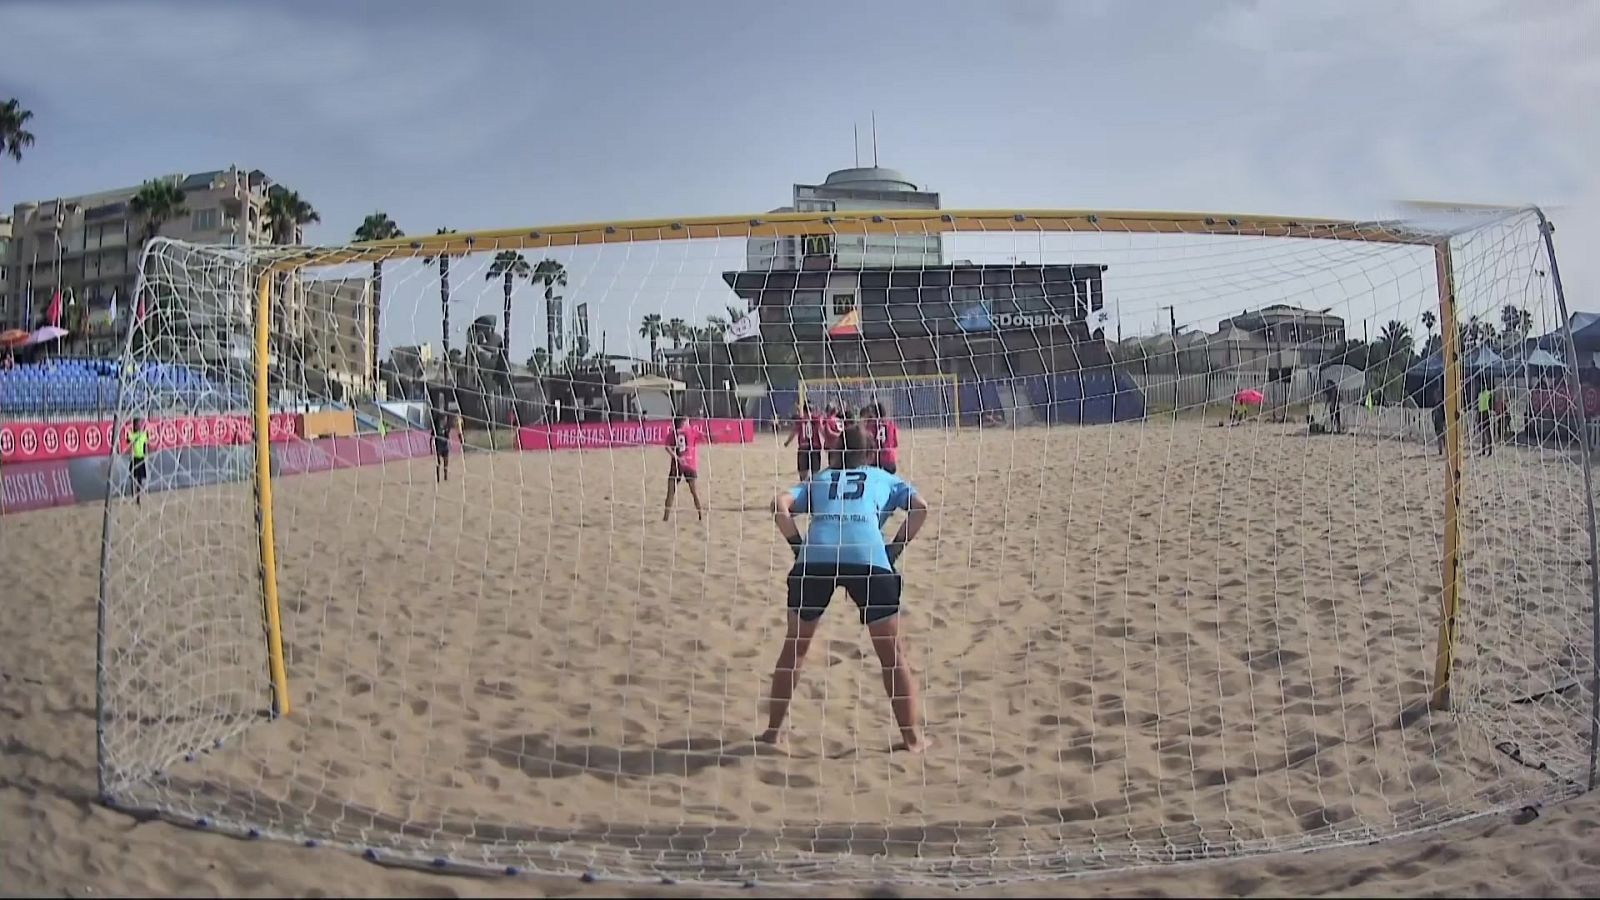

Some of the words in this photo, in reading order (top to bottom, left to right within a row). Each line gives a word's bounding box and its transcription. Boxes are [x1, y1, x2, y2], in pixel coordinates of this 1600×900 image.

[992, 311, 1071, 327] cDonald's
[611, 427, 643, 444] FUERA
[645, 426, 663, 442] DEL
[802, 421, 813, 440] 10
[677, 434, 687, 451] 9
[828, 471, 867, 500] 13
